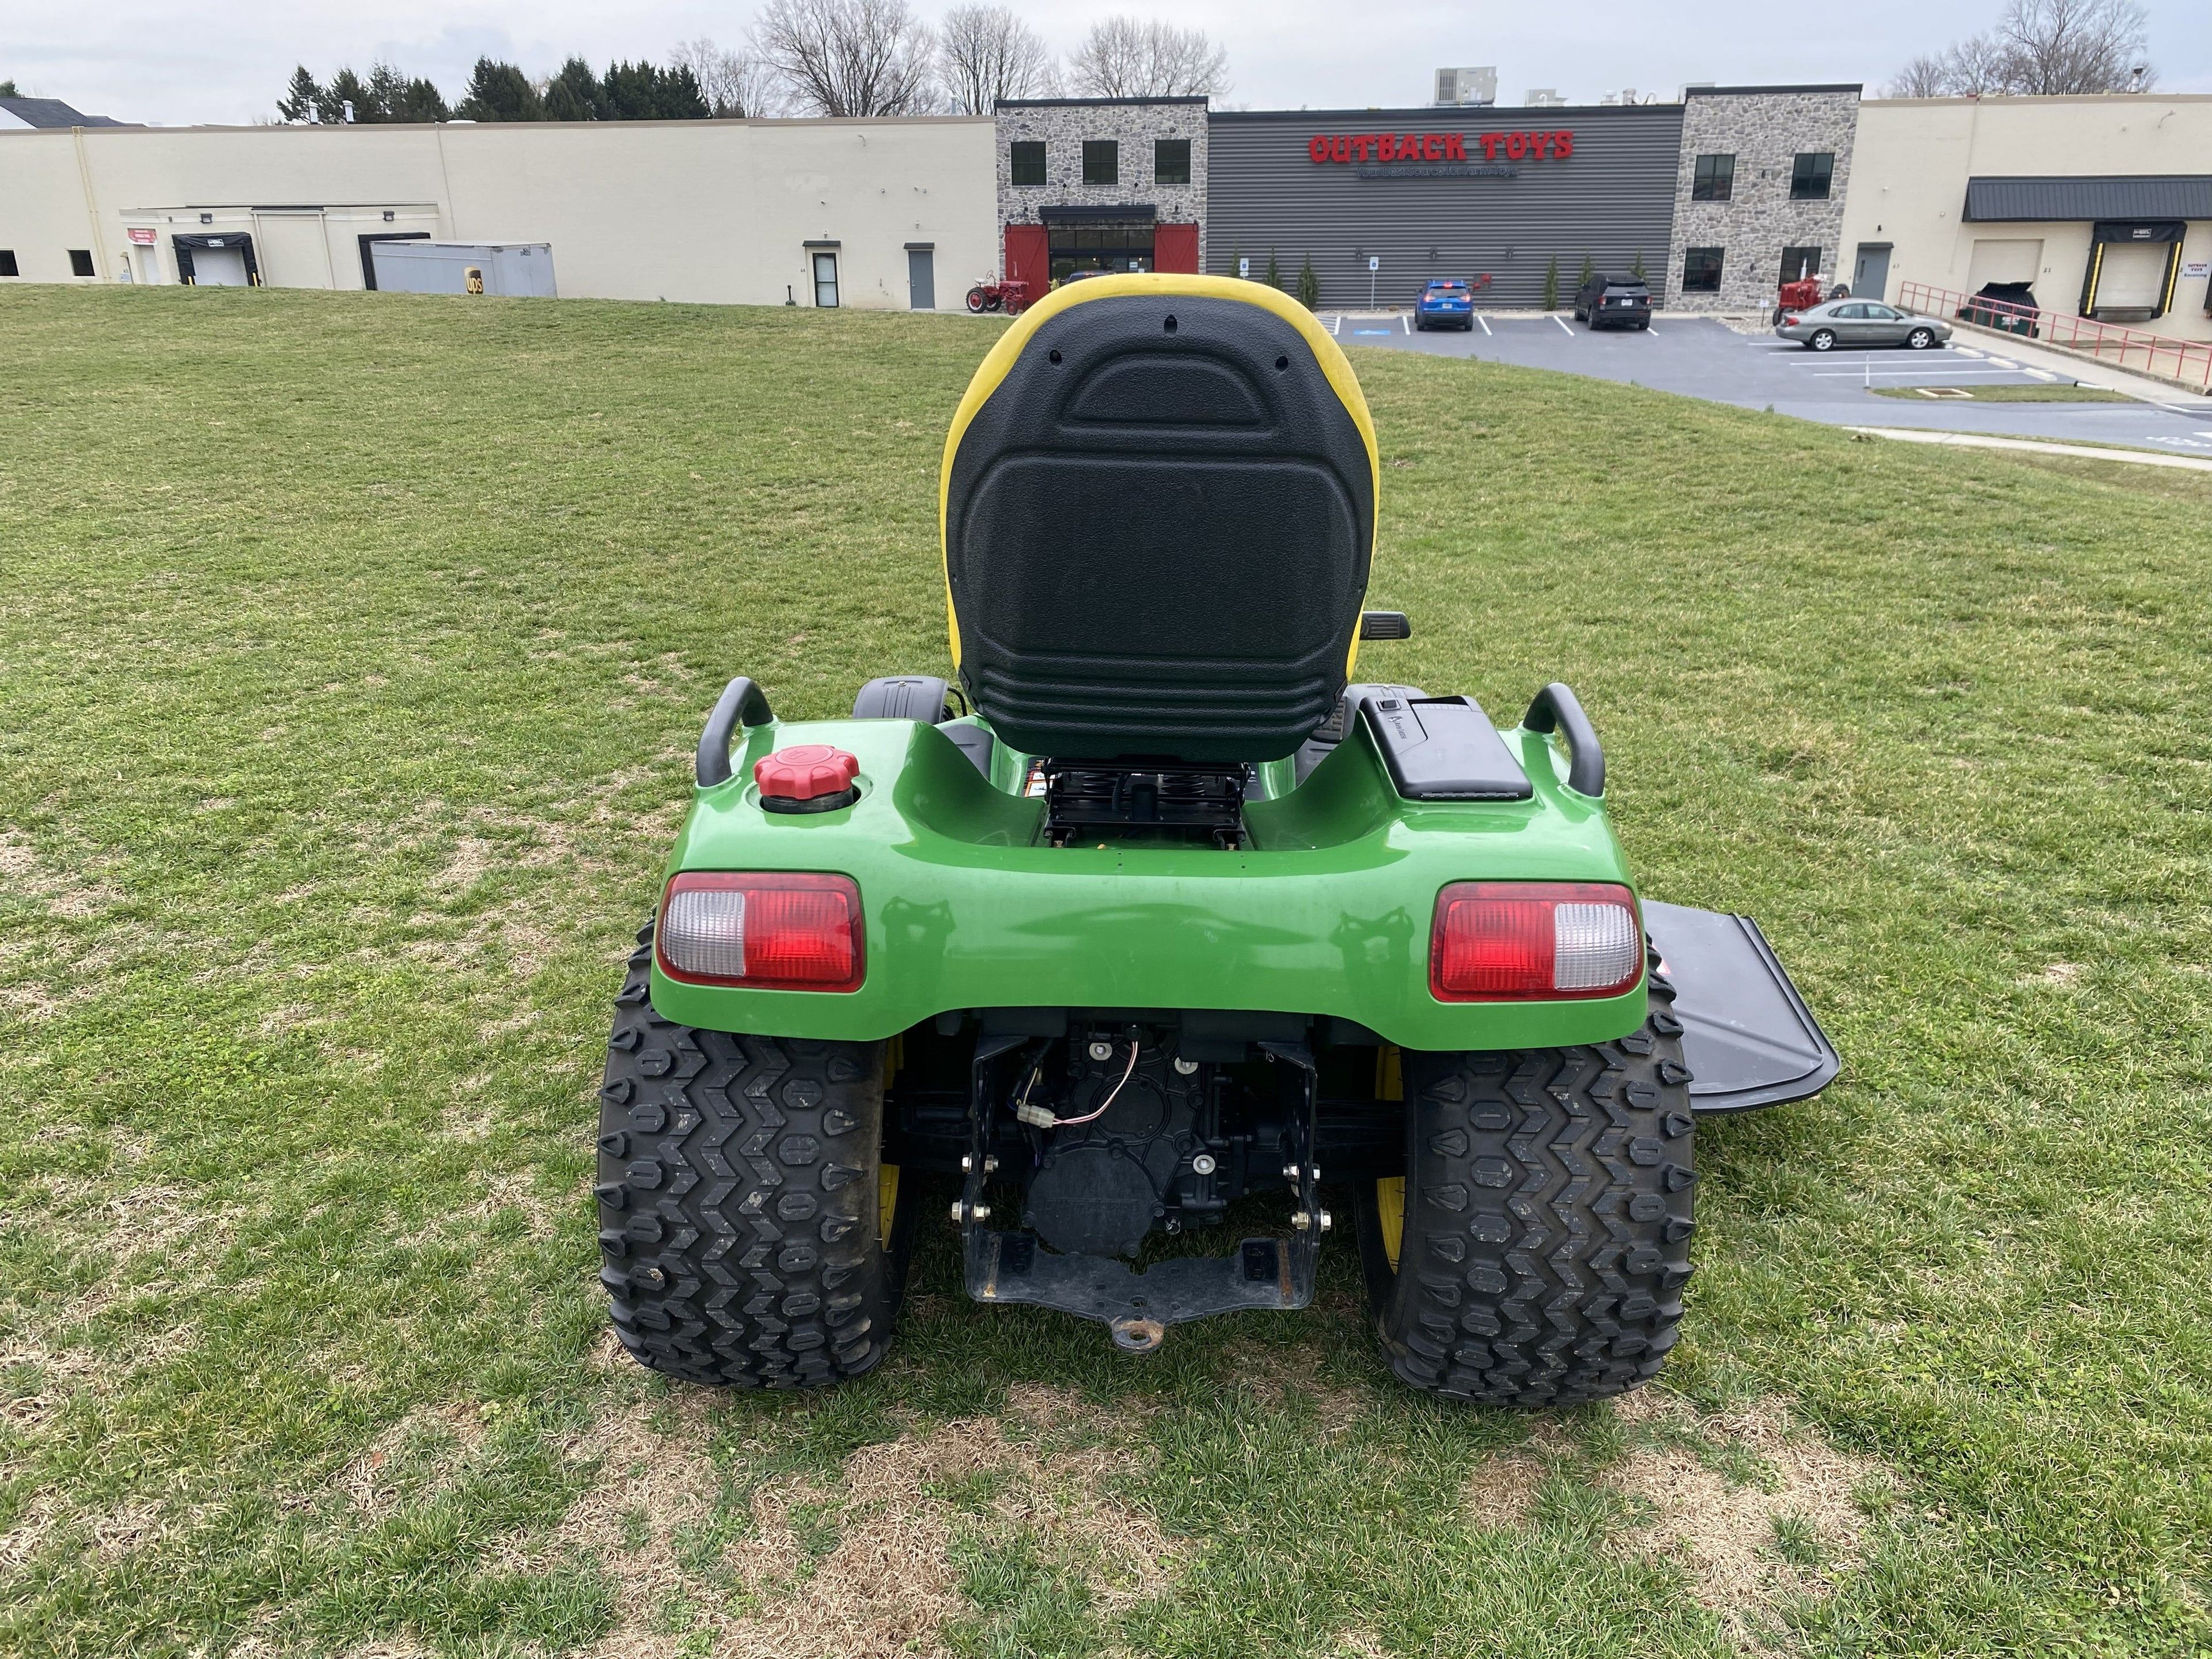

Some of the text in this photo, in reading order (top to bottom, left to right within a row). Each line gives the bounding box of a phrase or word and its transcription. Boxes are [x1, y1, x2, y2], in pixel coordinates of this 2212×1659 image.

[1309, 131, 1573, 162] OUTBACK TOYS
[1355, 166, 1379, 177] Your
[1382, 166, 1405, 176] Best
[1407, 165, 1444, 176] Source
[1465, 165, 1489, 175] Farm
[467, 277, 483, 294] ups
